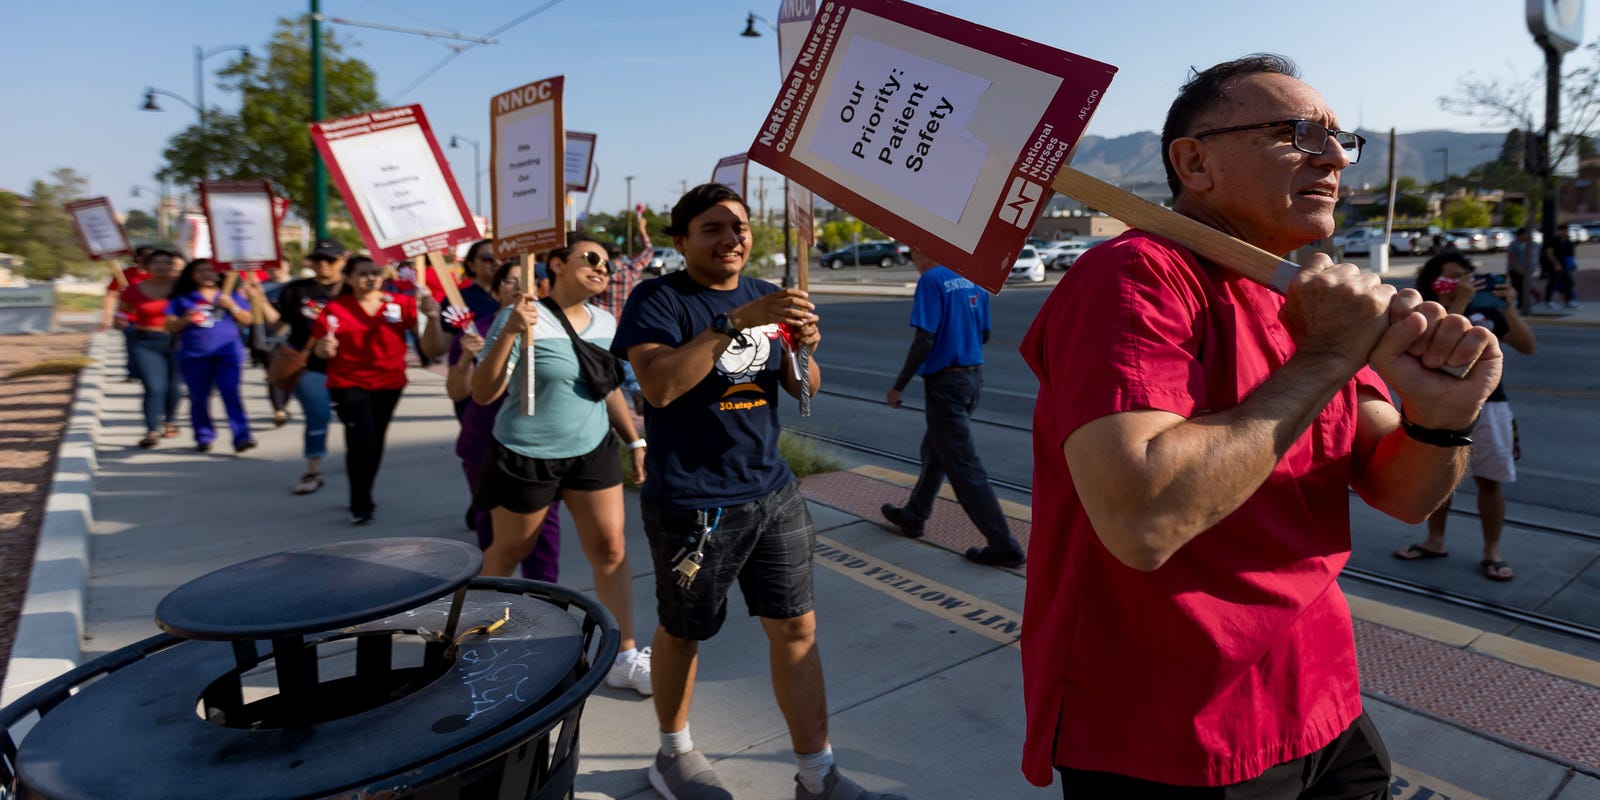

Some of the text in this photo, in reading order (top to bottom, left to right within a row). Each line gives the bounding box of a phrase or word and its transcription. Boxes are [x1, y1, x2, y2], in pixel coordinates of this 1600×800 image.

[498, 81, 552, 113] NNOC
[759, 1, 835, 147] National Nurses
[776, 5, 846, 153] Organizing Committee
[840, 80, 865, 123] Our
[1078, 89, 1099, 120] AFL-CIO
[851, 68, 904, 159] Priority:
[878, 82, 929, 165] Patient
[905, 96, 954, 172] Safety
[1019, 123, 1054, 173] National
[1028, 137, 1058, 178] Nurses
[1038, 141, 1069, 181] United
[815, 542, 1020, 637] HIND YELLOW LIN
